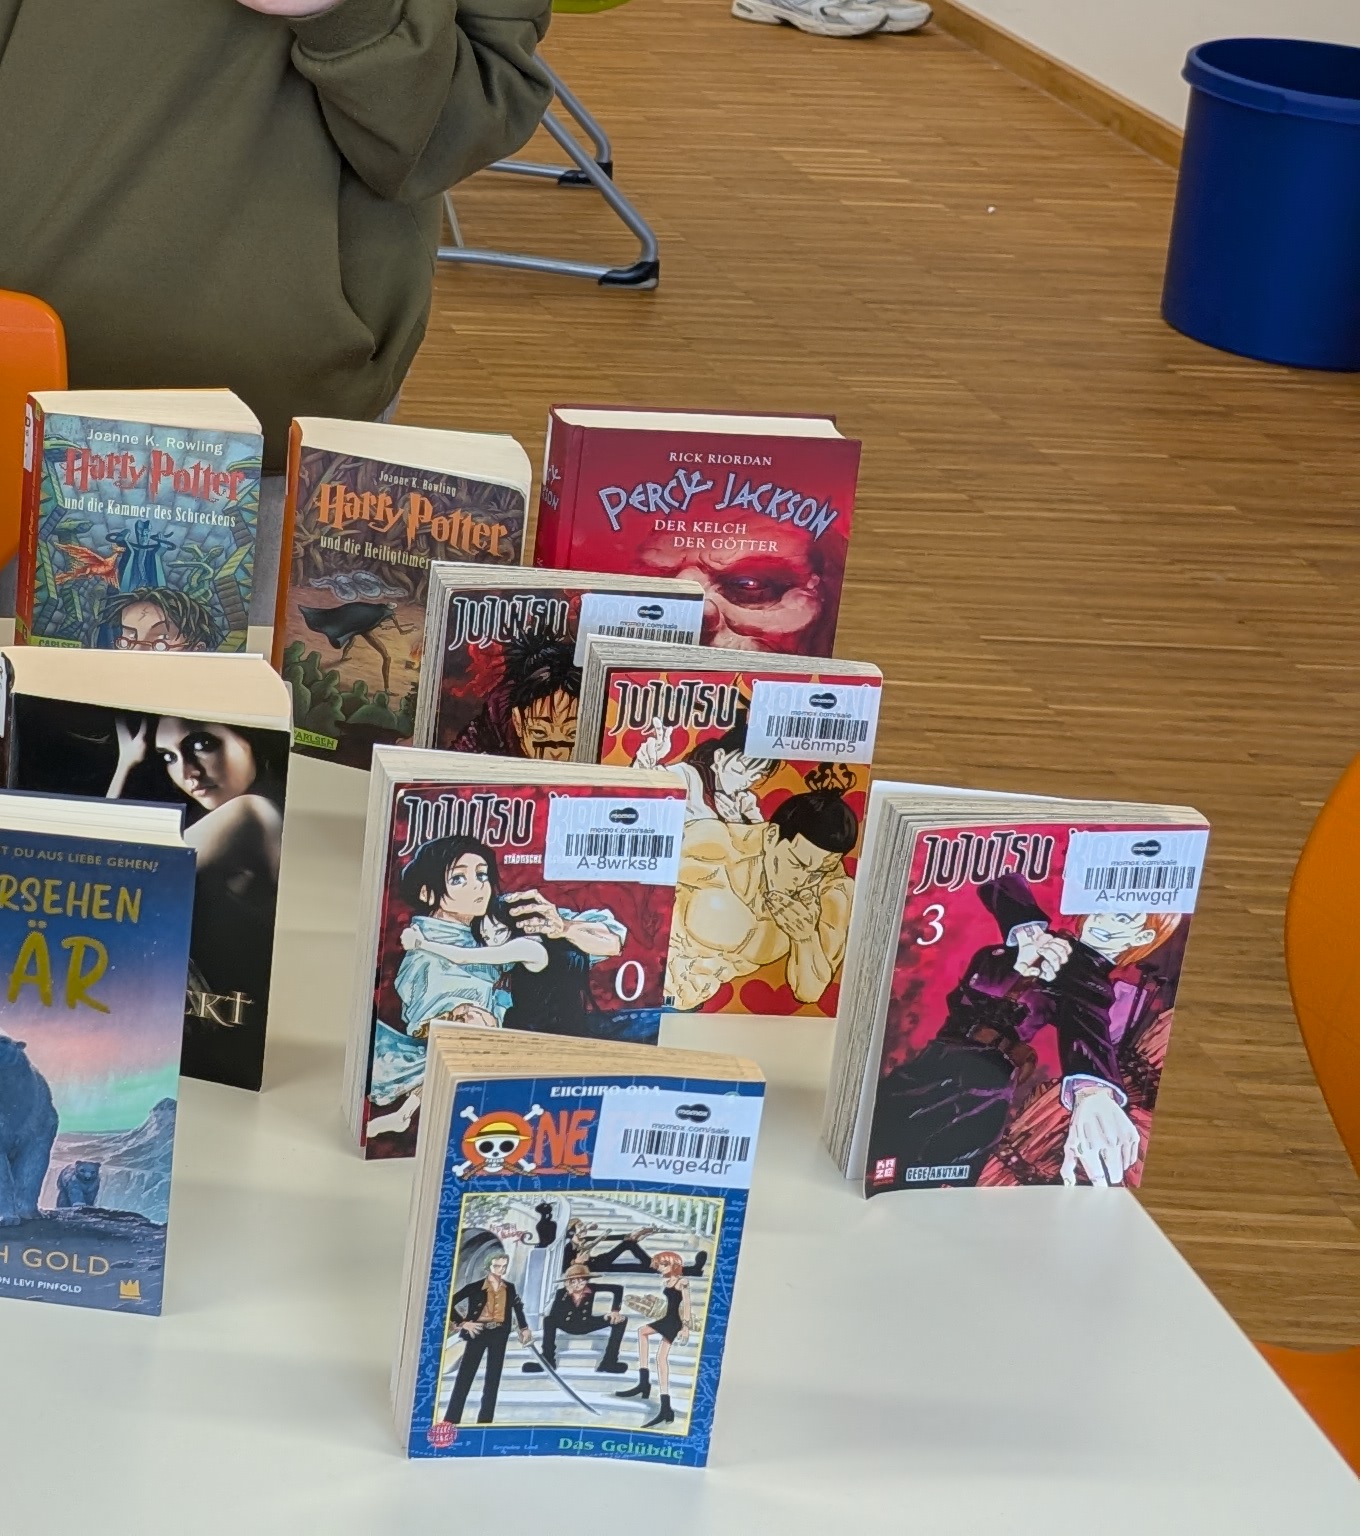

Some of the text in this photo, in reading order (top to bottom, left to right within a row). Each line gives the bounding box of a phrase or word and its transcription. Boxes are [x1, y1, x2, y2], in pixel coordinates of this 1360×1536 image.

[87, 429, 223, 456] Joanne K. Rowling
[669, 452, 772, 466] RICK RIORDAN
[63, 447, 245, 503] Harry Potter
[64, 496, 236, 528] und die Kammer des Schreckens
[598, 469, 713, 532] PERCY
[714, 473, 839, 542] JACKSON
[317, 483, 508, 556] Harry Potter
[654, 519, 747, 535] DER KELCH
[673, 535, 779, 552] DER GÖTTER
[609, 680, 739, 736] JUJUTSU
[772, 737, 857, 755] A-u6nmp5
[14, 847, 33, 859] DU
[37, 849, 64, 862] AUS
[68, 853, 102, 866] LIEBE
[577, 857, 658, 871] A-8wrks8
[913, 830, 1054, 895] JUJUTSU
[1095, 886, 1179, 905] A-knwgqf
[916, 904, 945, 946] 3
[615, 960, 645, 1002] 0
[651, 1122, 730, 1135] momox.com/sale
[632, 1153, 732, 1175] A-wge4dr
[907, 1166, 968, 1180] GEGE AKUTAMI
[22, 1247, 110, 1276] GOLD
[13, 1276, 35, 1288] LEVI
[37, 1279, 82, 1294] PINFOLD
[559, 1437, 685, 1460] Das Gelübde
